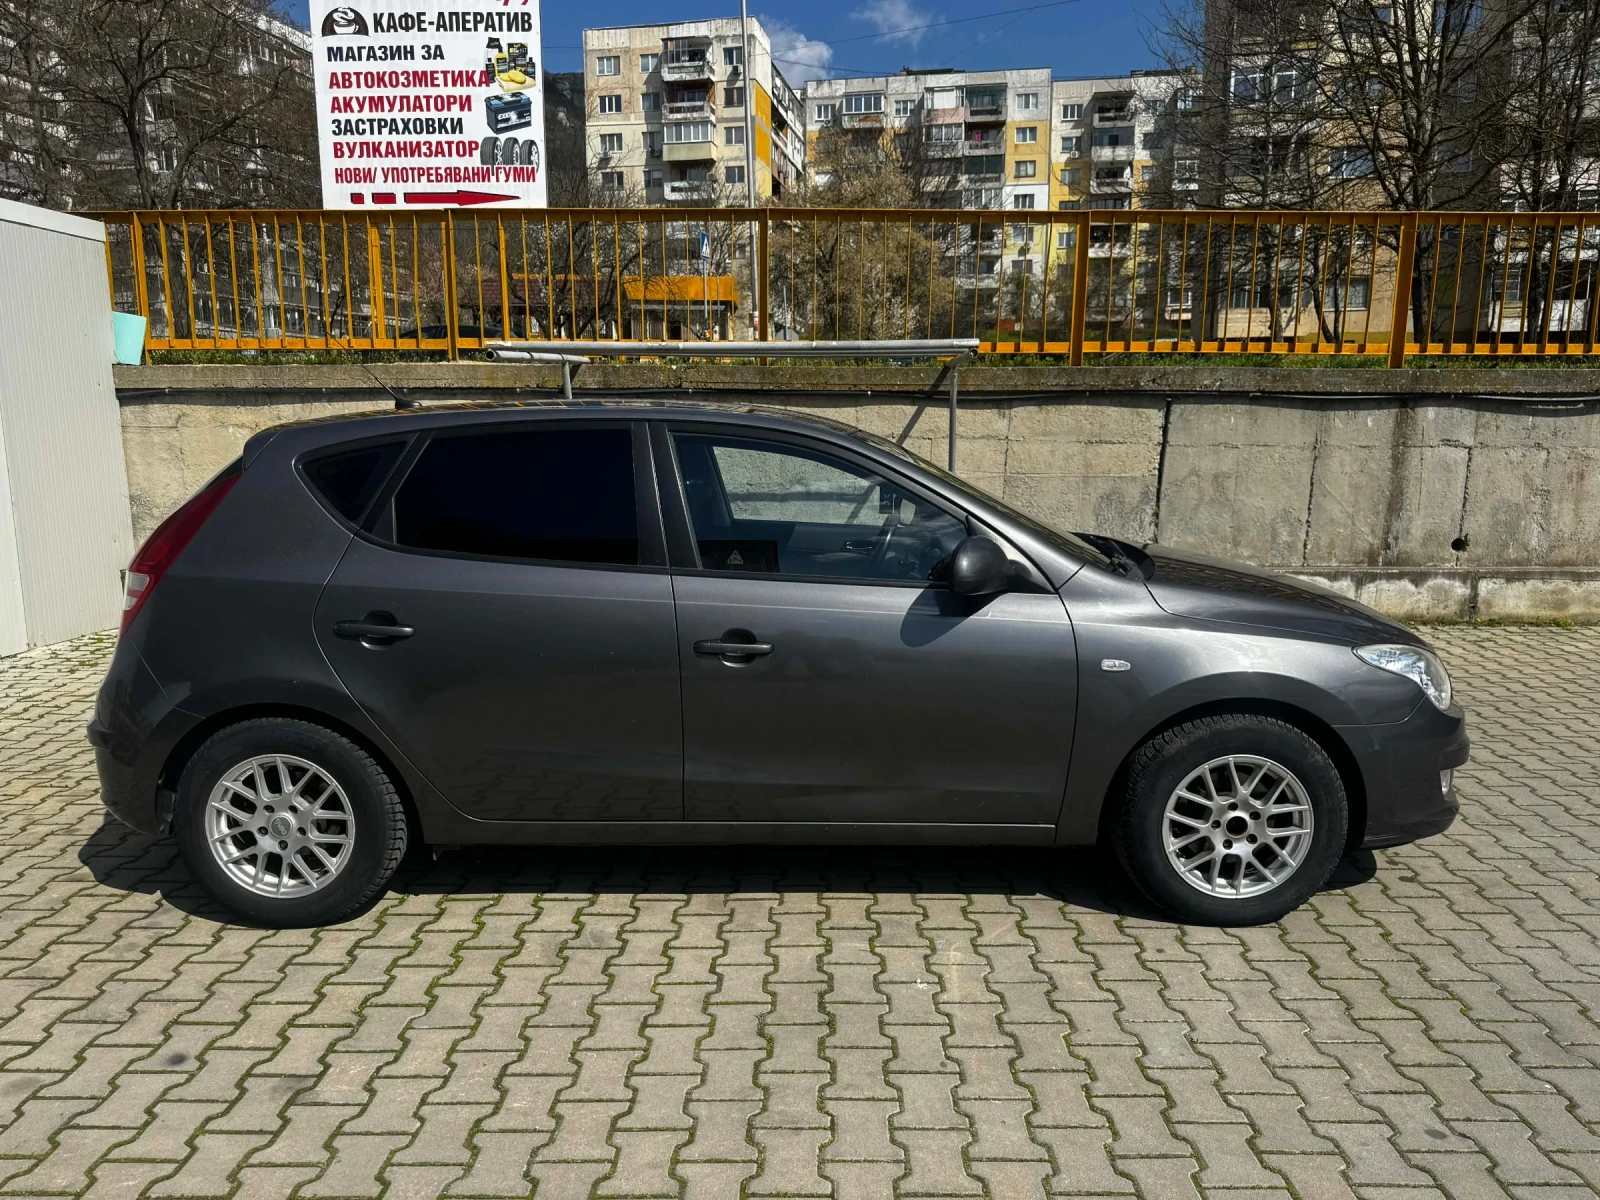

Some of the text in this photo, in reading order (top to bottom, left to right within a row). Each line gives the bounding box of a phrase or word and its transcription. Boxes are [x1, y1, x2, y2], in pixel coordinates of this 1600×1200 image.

[373, 12, 532, 33] КАФЕ-АПЕРАТИВ
[327, 45, 445, 62] МАГАЗИН ЗА
[329, 70, 490, 89] АВТОКОЗМЕТИКА
[331, 95, 472, 113] АКУМУЛАТОРИ
[332, 118, 463, 136] ЗАСТРАХОВКИ
[333, 141, 479, 158] ВУЛКАНИЗАТОР
[335, 166, 536, 184] НОВИ/ УПОТРЕБЯВАНИ ГУМИ
